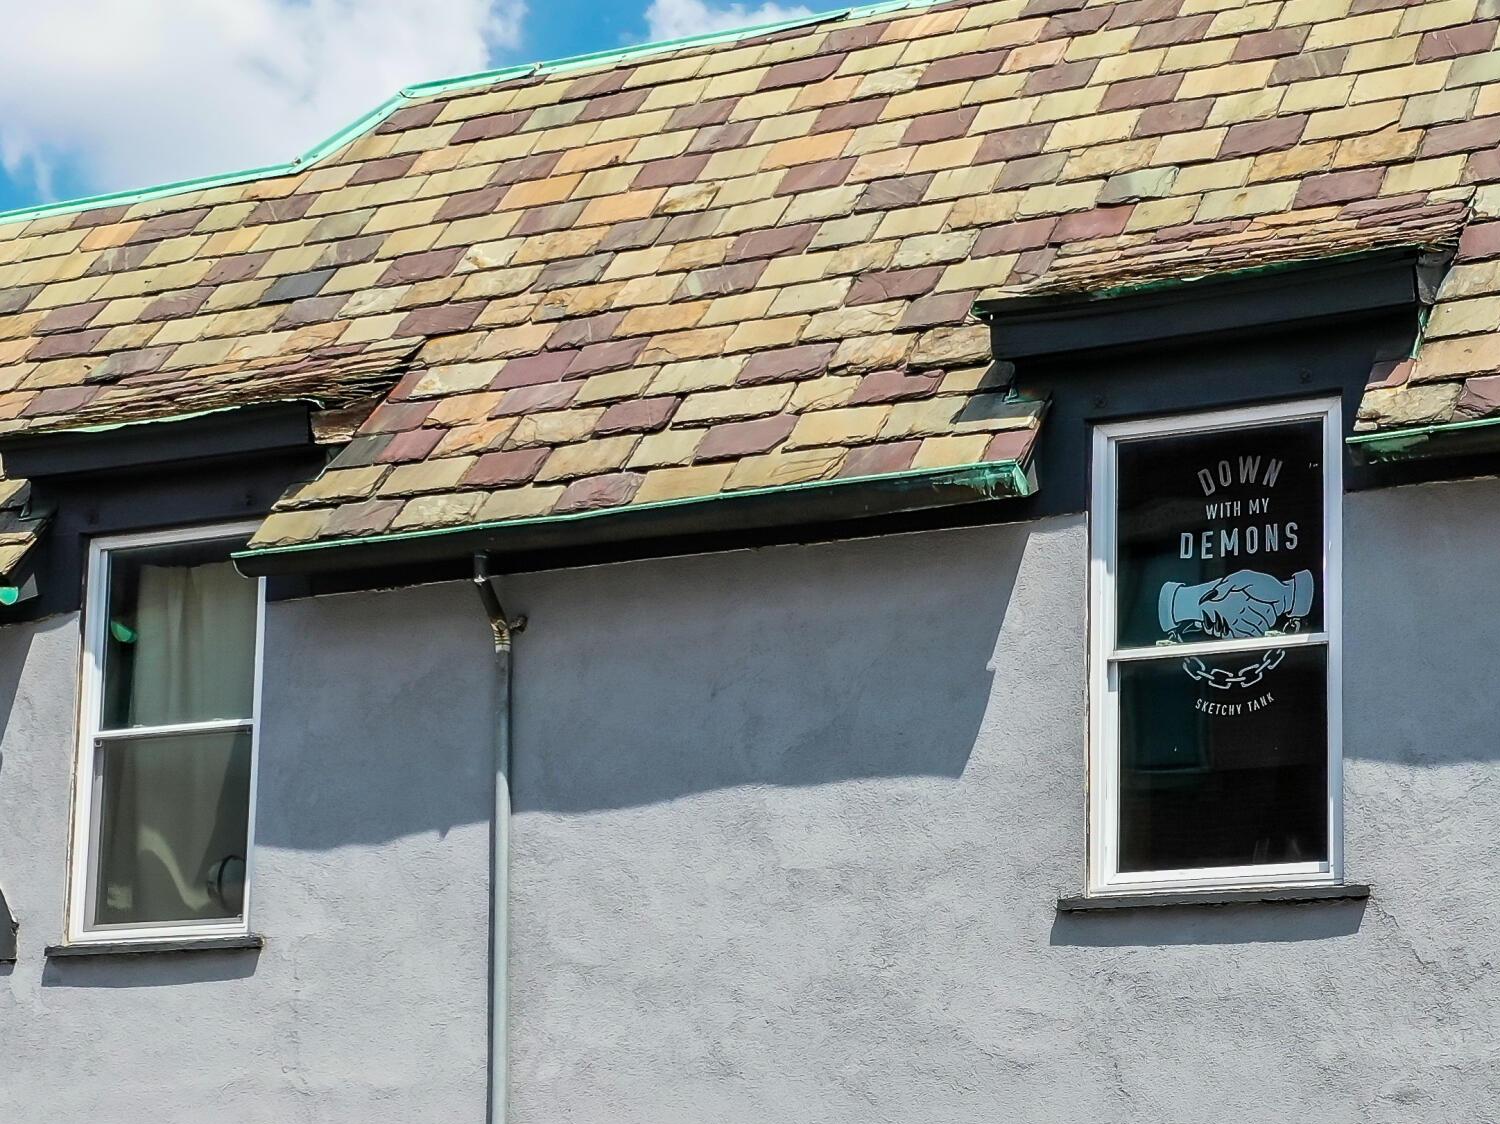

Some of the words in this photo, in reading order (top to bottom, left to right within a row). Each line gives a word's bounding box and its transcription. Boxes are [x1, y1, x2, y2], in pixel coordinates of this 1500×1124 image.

[1197, 455, 1283, 497] DOWN
[1205, 501, 1241, 520] WITH
[1249, 498, 1270, 515] MY
[1179, 521, 1299, 560] DEMONS
[1194, 698, 1242, 716] SKETCHY
[1247, 692, 1275, 712] TANK
